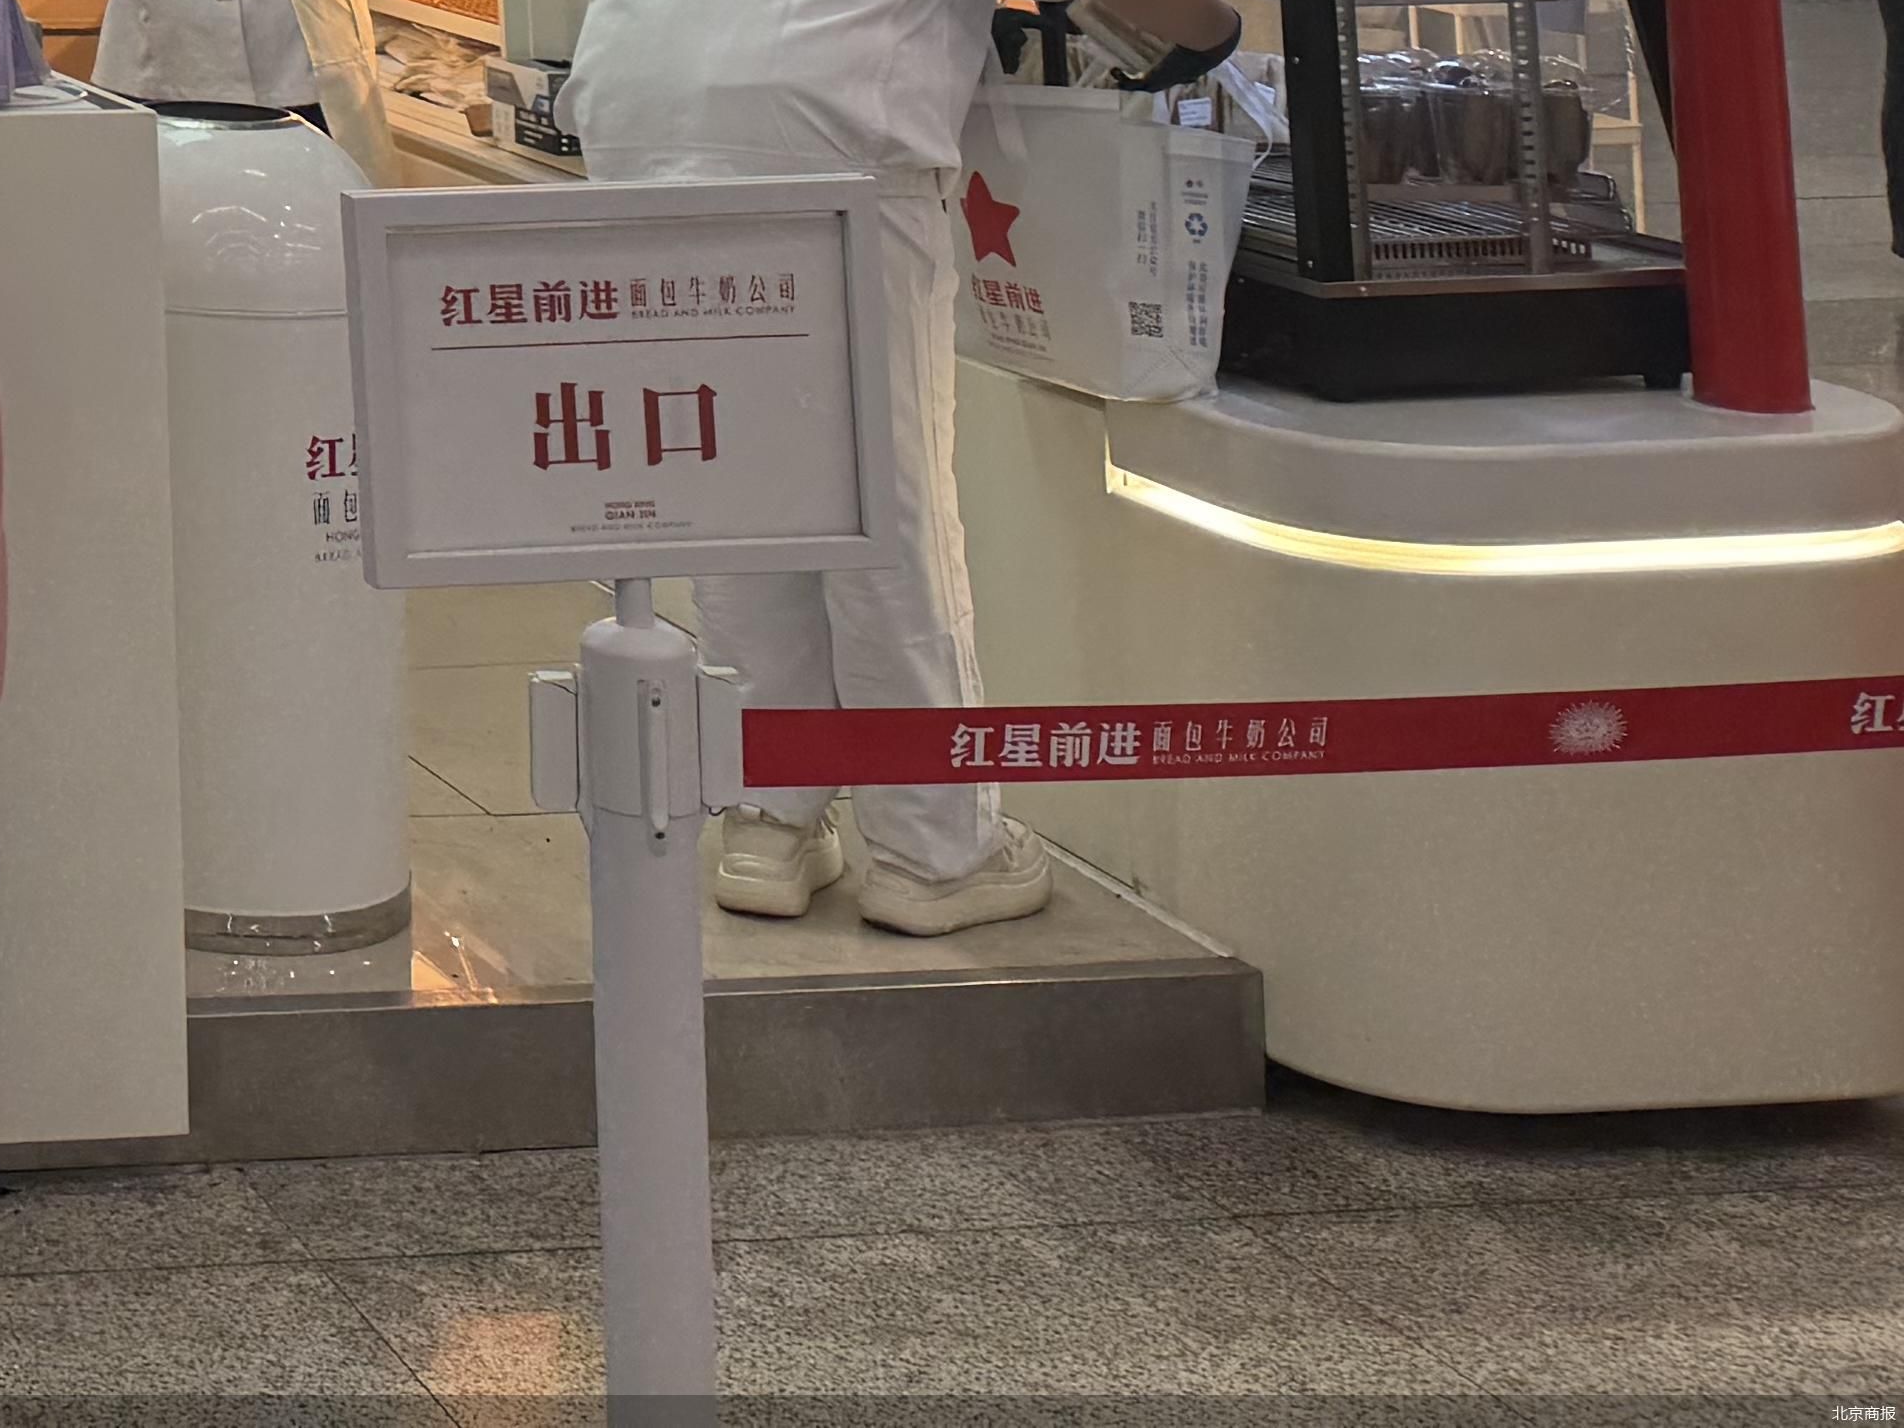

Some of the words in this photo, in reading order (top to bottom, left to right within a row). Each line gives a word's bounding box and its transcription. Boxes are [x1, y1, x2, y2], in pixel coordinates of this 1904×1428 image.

[441, 279, 620, 326] 红星前进
[630, 274, 795, 308] 面包牛奶公司
[632, 309, 669, 320] BREAD
[674, 309, 697, 318] AND
[735, 306, 795, 316] COMPANY
[533, 382, 718, 471] 出口
[1851, 692, 1904, 734] 红
[950, 721, 1142, 768] 红星前进
[1152, 716, 1328, 753] 面包牛奶公司
[1152, 755, 1192, 766] BREAD
[1262, 751, 1326, 761] COMPANY
